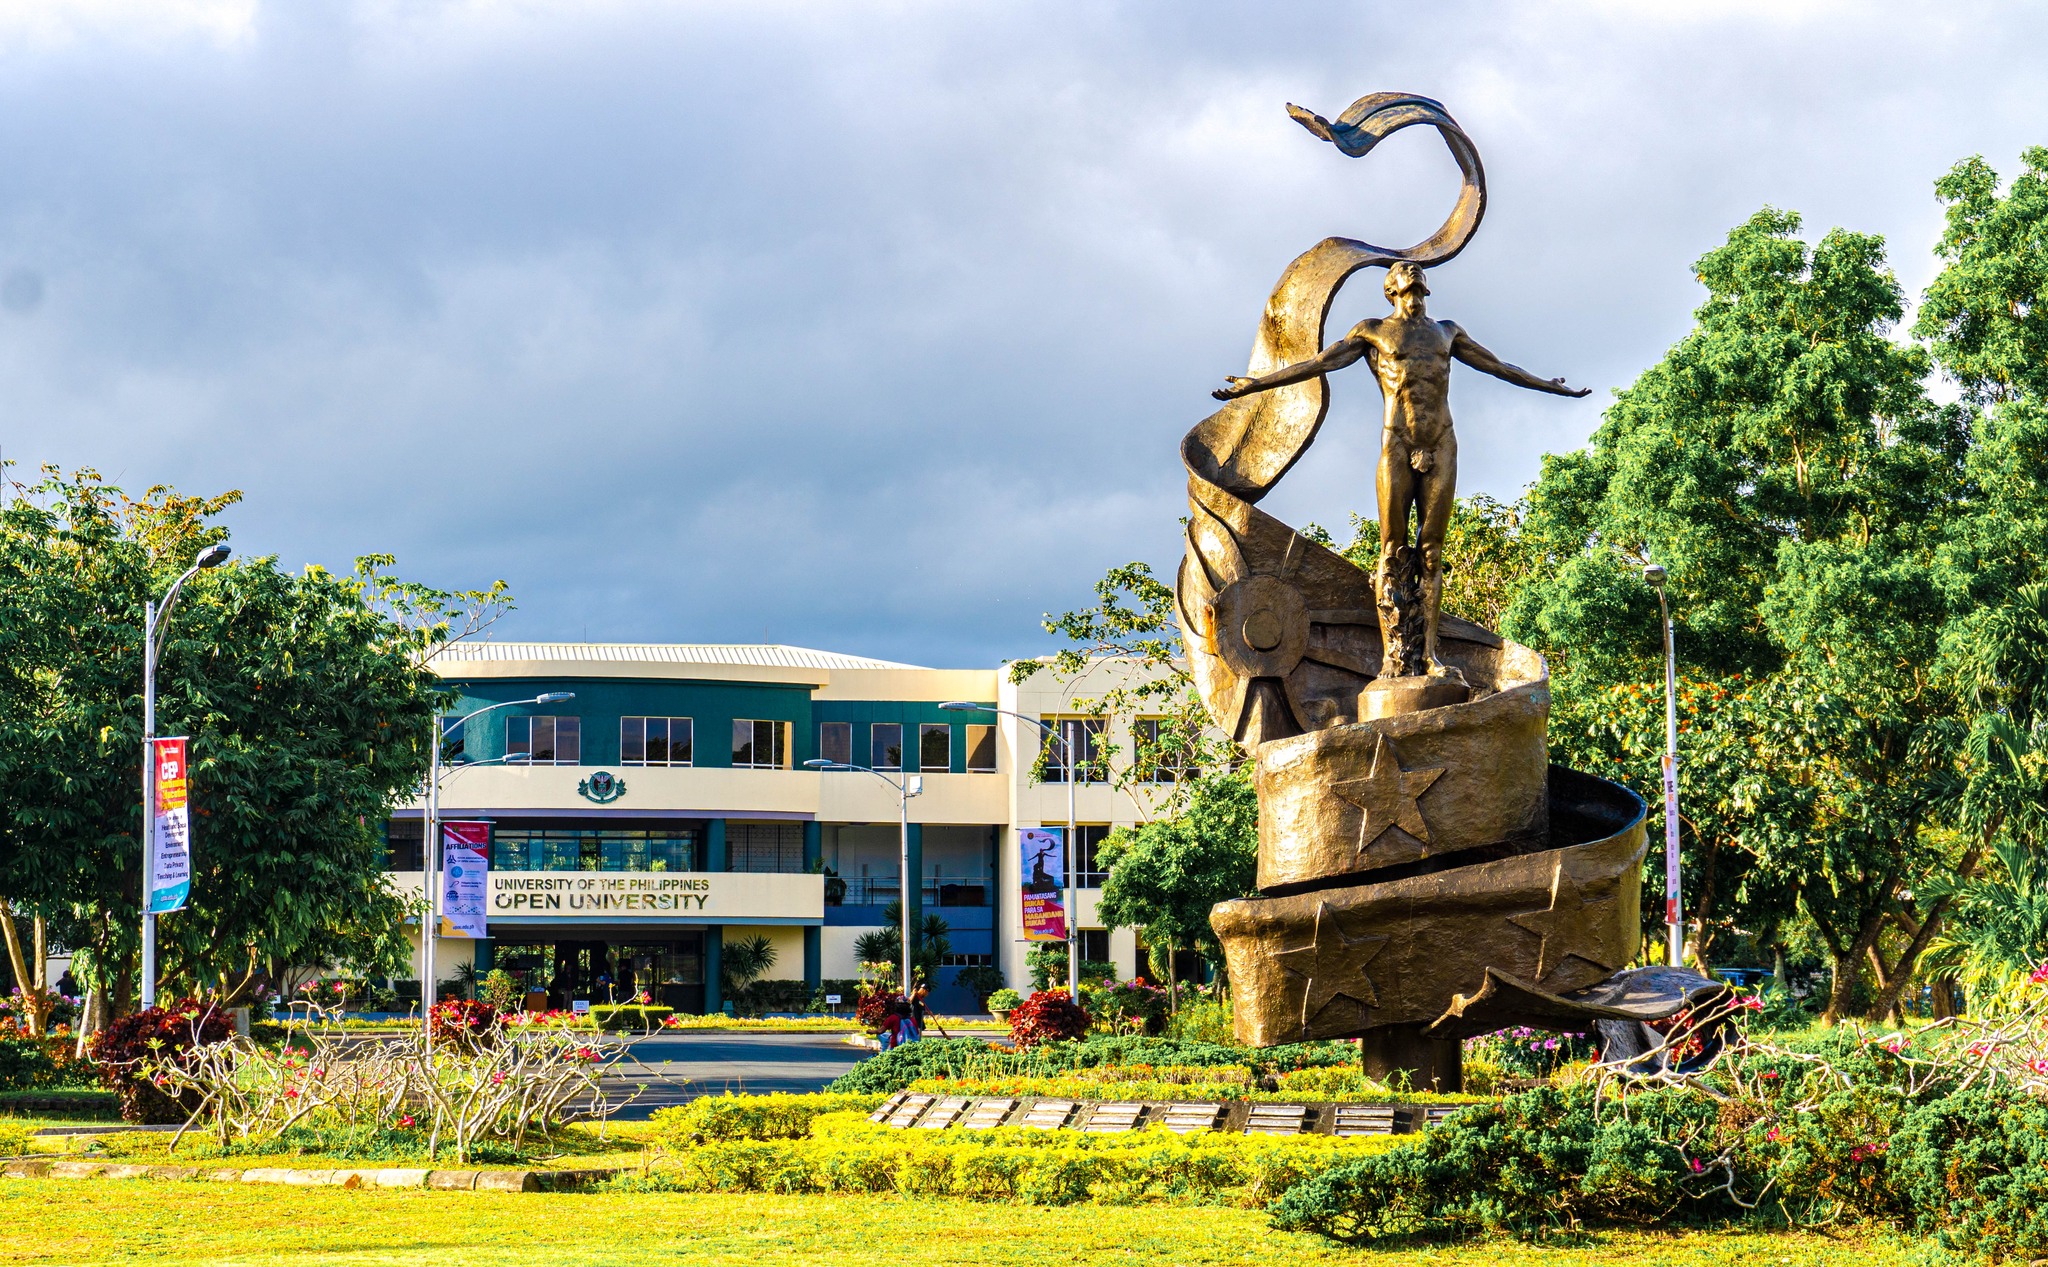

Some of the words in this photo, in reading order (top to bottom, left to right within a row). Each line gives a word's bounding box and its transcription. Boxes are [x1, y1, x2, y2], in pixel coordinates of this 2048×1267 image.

[161, 761, 178, 780] CEP
[445, 842, 487, 850] AFFILIATIONS
[495, 878, 573, 890] UNIVERSITY
[577, 879, 595, 890] OF
[601, 879, 625, 890] THE
[629, 879, 710, 891] PHILIPPINES
[494, 893, 561, 910] OPEN
[569, 893, 710, 910] UNIVERSITY
[1023, 892, 1057, 901] PAMANTASANG
[1023, 899, 1045, 908] BUKAS
